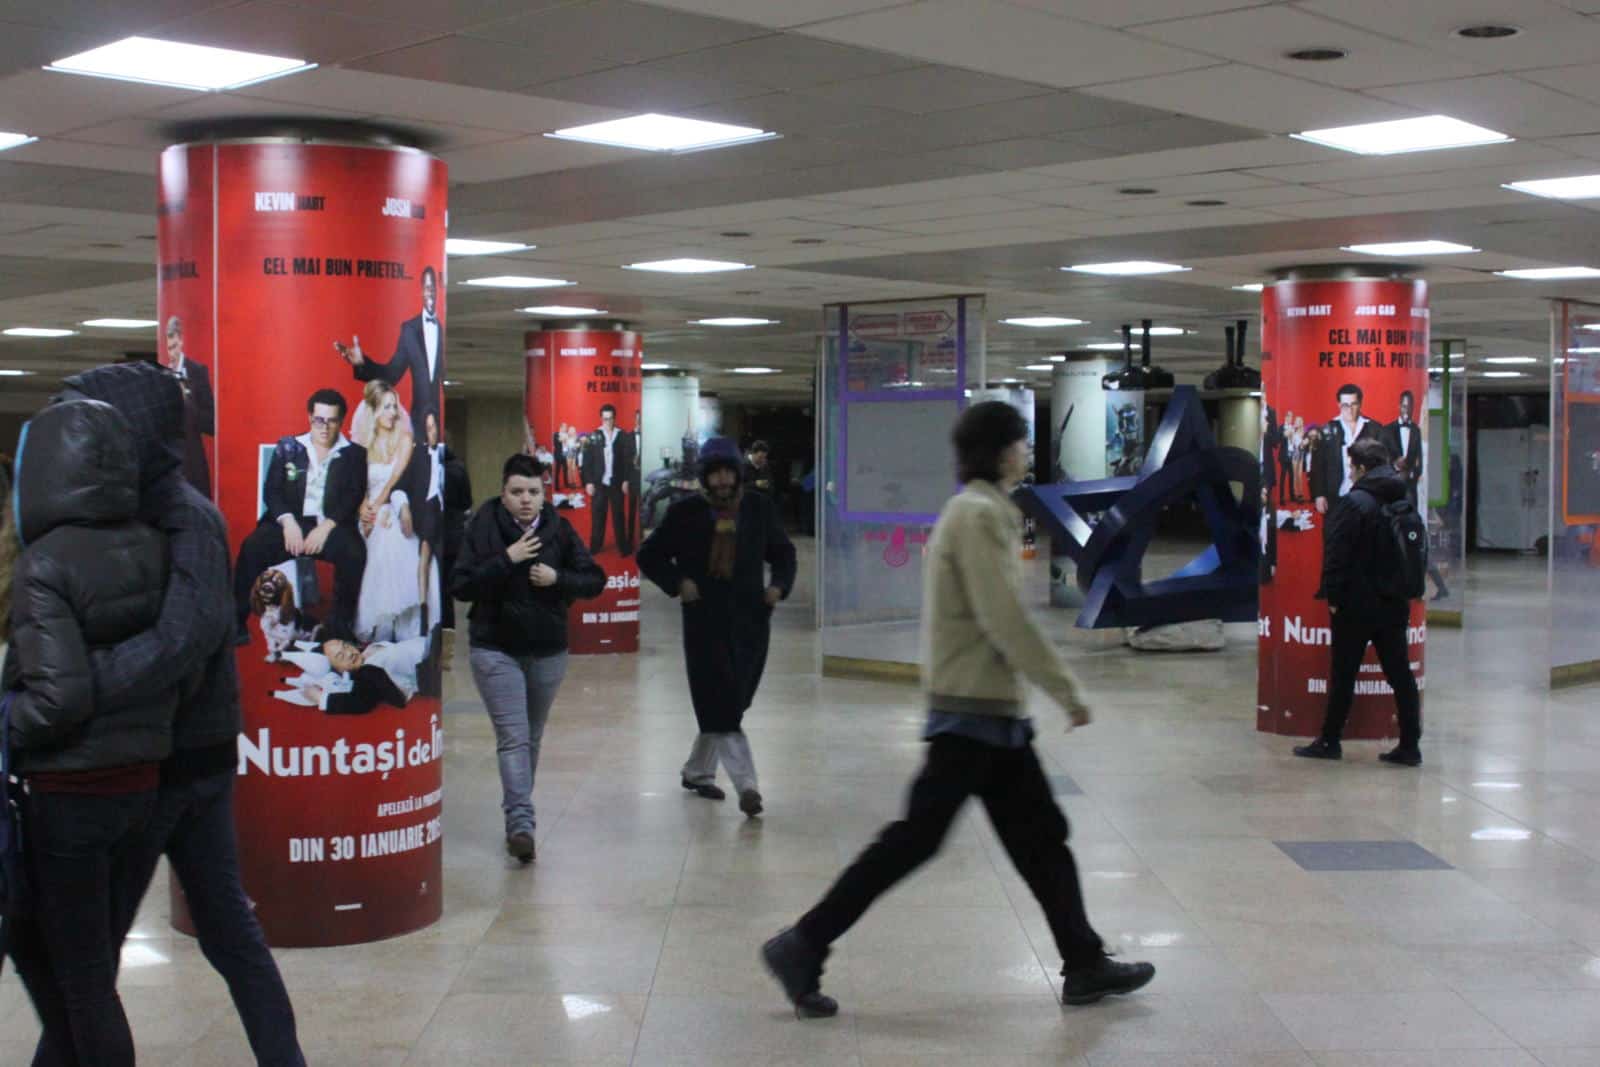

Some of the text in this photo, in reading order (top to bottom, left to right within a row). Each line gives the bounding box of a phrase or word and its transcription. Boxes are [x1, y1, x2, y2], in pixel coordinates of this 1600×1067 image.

[254, 191, 295, 212] KEVIN
[263, 257, 287, 275] CEL
[293, 258, 320, 275] MAI
[326, 258, 352, 276] BUN
[1329, 329, 1350, 345] CEL
[1356, 329, 1381, 345] MAI
[1319, 351, 1333, 367] PE
[1338, 351, 1371, 368] CARE
[1284, 615, 1331, 646] Nun
[1307, 678, 1327, 694] DIN
[408, 738, 431, 767] de
[289, 838, 324, 862] DIN
[330, 836, 355, 860] 30
[361, 823, 424, 858] IANUARIE
